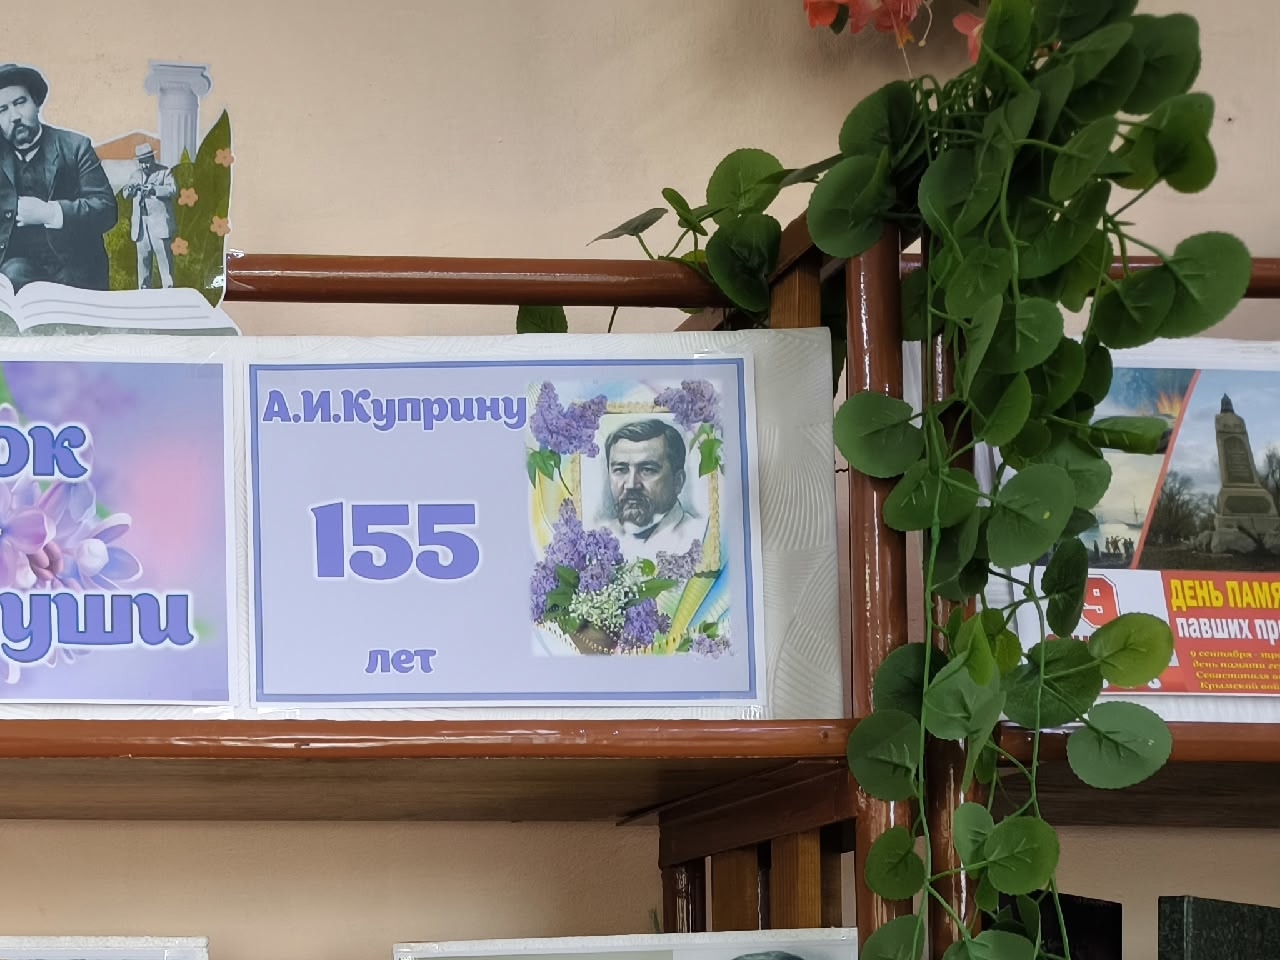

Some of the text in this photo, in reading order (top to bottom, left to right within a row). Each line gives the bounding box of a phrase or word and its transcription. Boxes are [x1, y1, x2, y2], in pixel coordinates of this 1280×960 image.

[262, 388, 527, 430] А.И.Куприну
[310, 501, 480, 580] 155
[1170, 579, 1223, 612] ДЕНЬ
[1176, 618, 1280, 646] павших пр
[365, 647, 437, 674] лет
